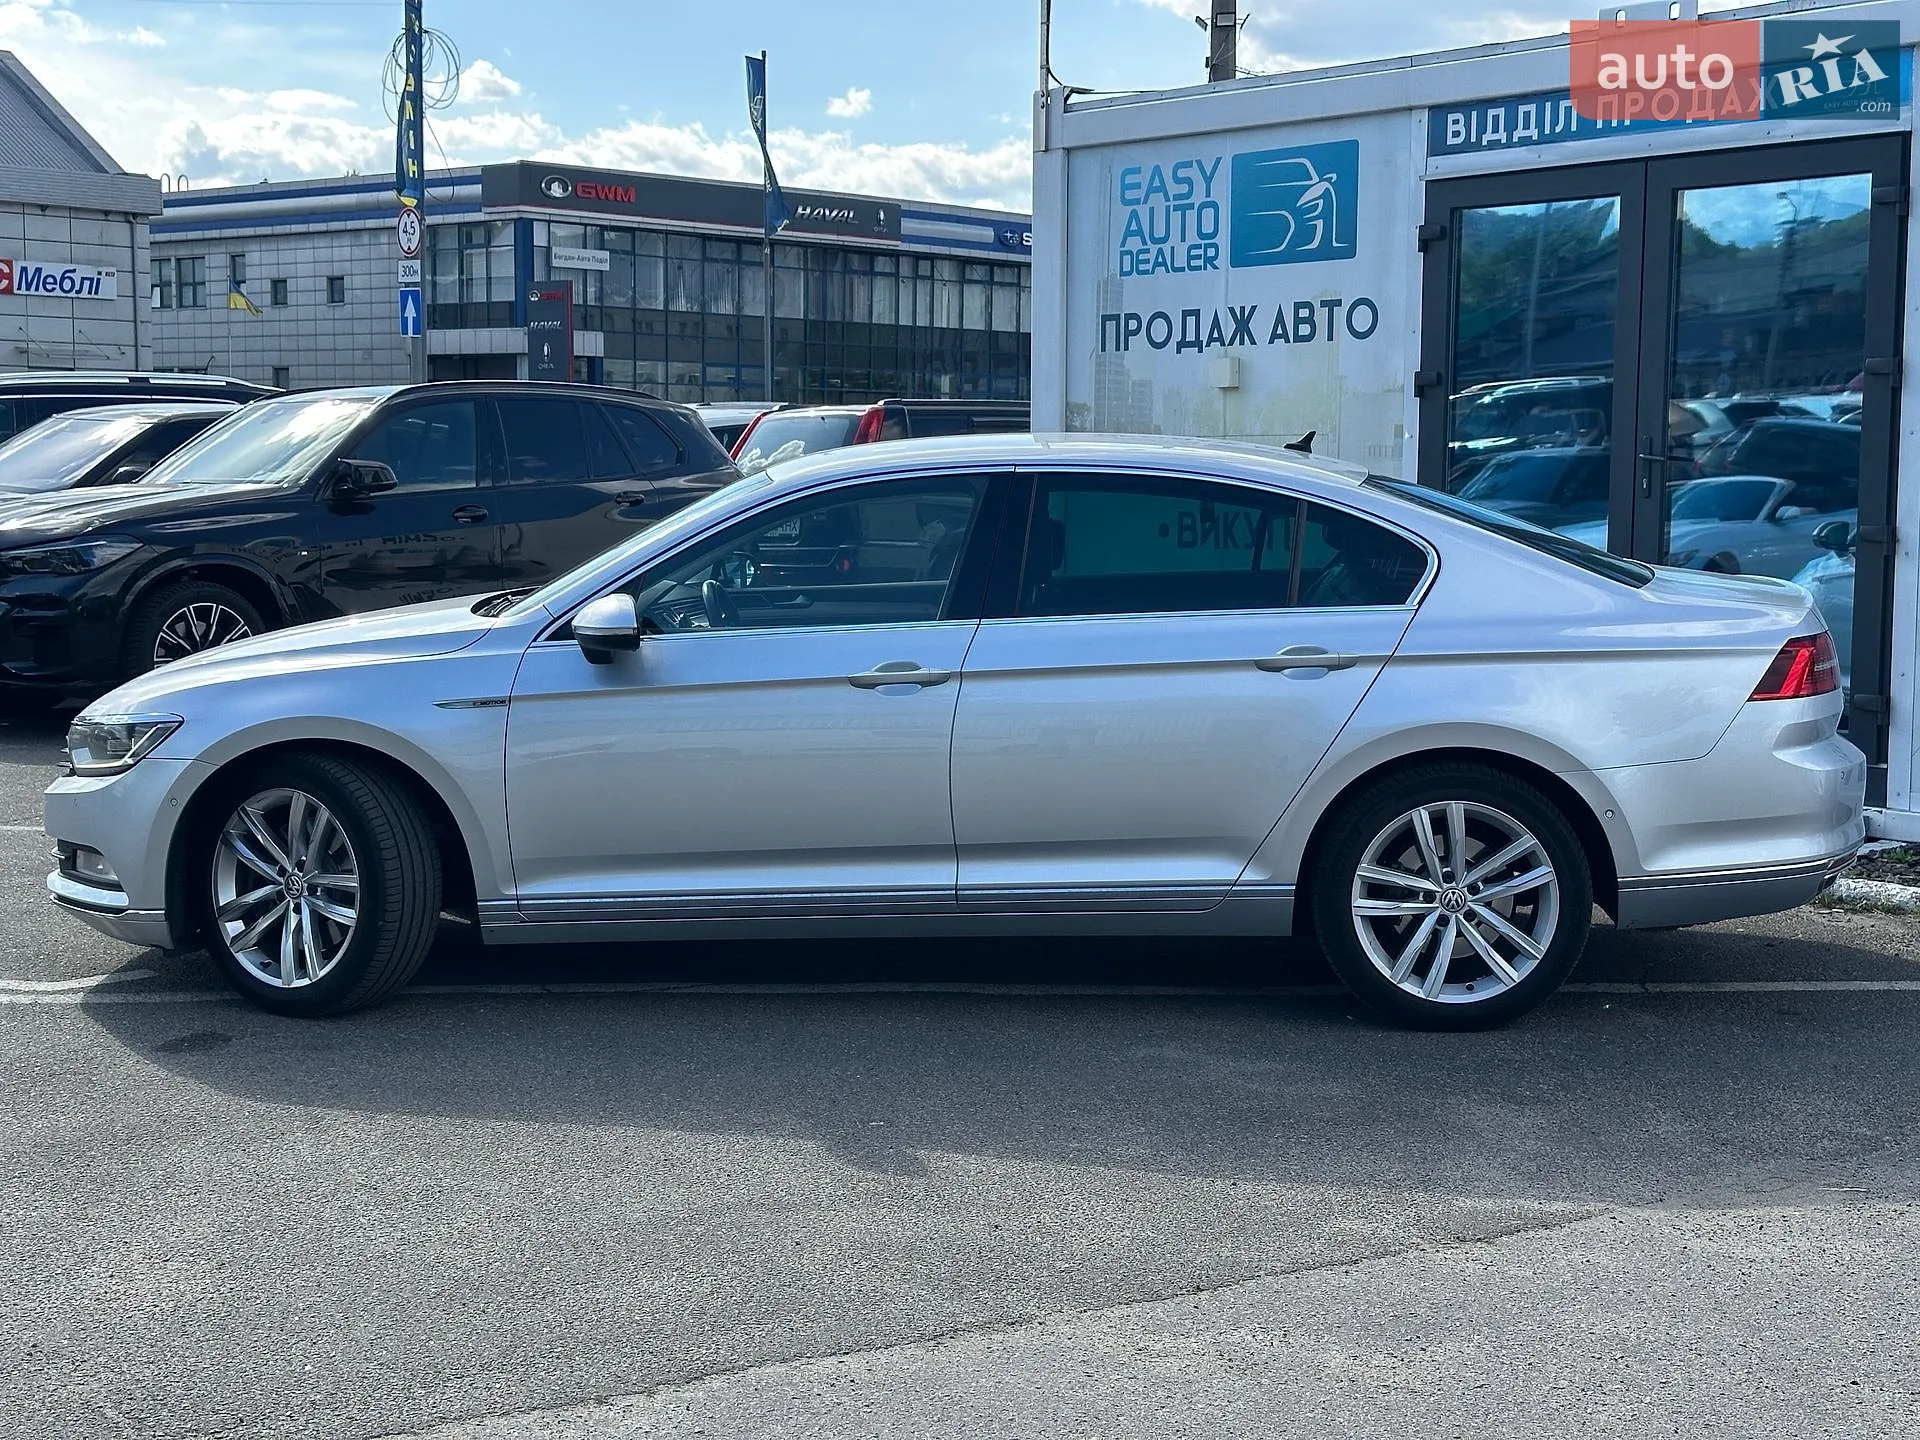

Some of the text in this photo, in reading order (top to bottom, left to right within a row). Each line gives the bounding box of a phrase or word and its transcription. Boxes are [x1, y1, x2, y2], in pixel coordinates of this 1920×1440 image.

[1446, 73, 1804, 145] ВІДДІЛ ПРОДАЖ
[576, 182, 636, 203] GWM
[1120, 157, 1222, 206] EASY
[794, 205, 859, 224] HAVAL
[1120, 201, 1219, 248] AUTO
[1120, 242, 1219, 277] DEALER
[17, 266, 102, 295] Меблі
[1101, 297, 1379, 354] ПРОДАЖ АВТО
